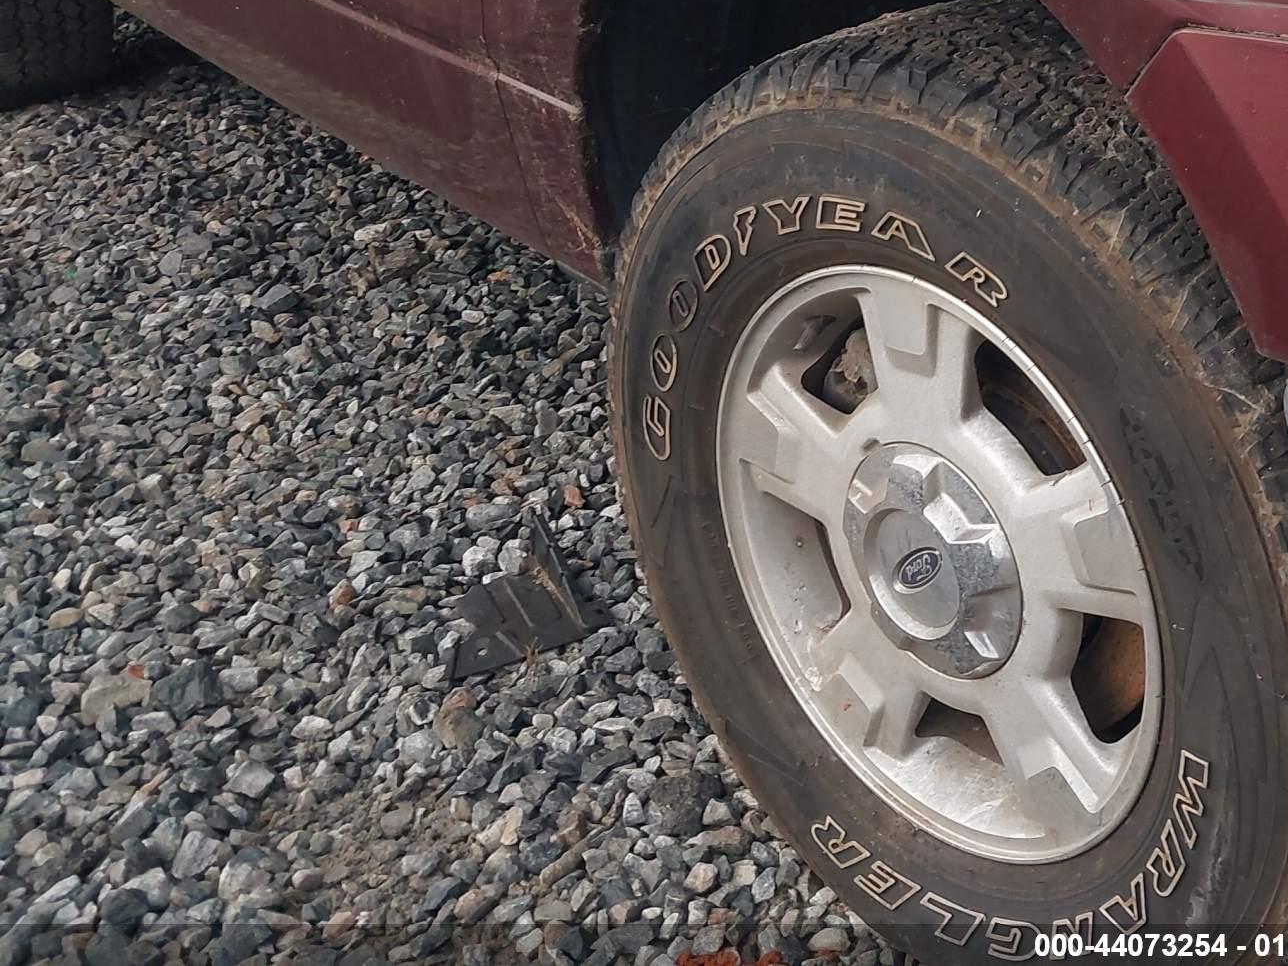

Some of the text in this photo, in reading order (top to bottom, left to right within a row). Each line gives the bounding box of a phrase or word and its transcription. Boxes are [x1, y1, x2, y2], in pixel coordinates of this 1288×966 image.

[642, 194, 1009, 461] GOODYEAR
[904, 553, 933, 582] Ford
[810, 749, 1209, 961] WRANGLER
